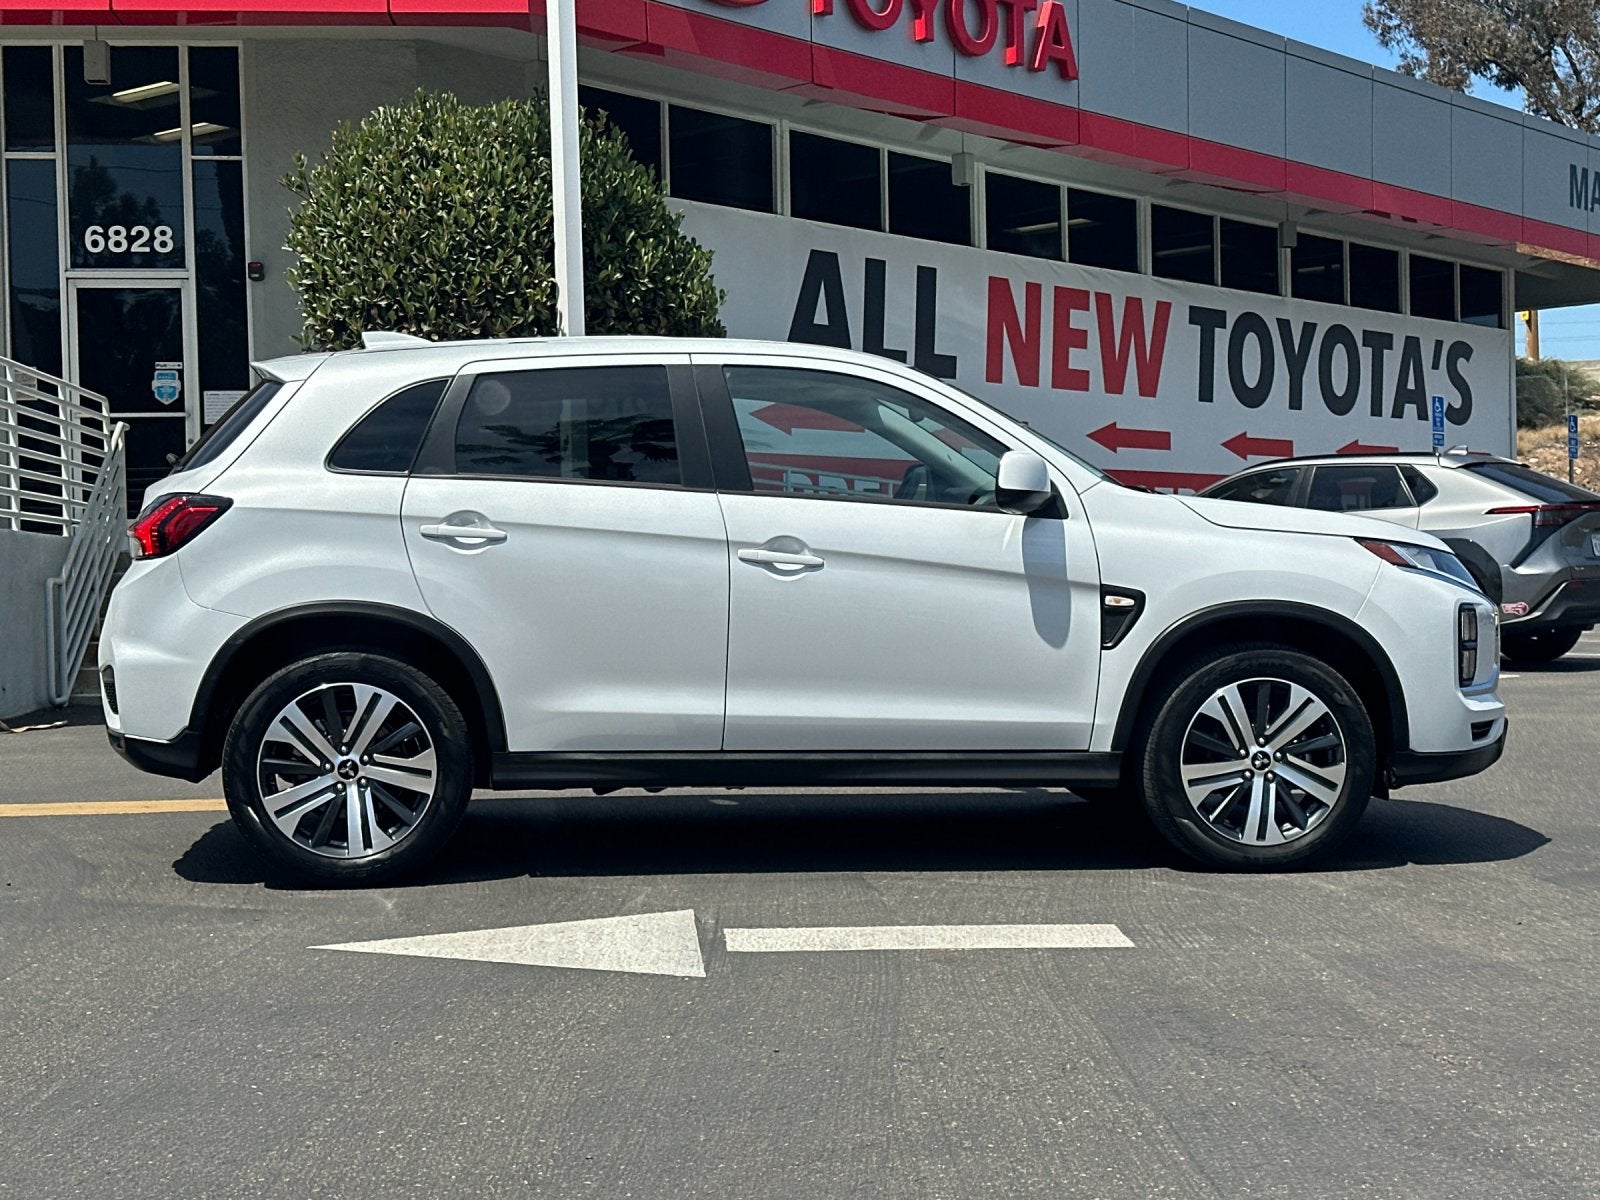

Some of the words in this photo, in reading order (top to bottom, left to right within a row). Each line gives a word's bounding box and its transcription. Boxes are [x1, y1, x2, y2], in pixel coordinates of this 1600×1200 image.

[84, 225, 174, 253] 6828
[786, 249, 957, 379] ALL
[985, 275, 1172, 398] NEW
[1188, 305, 1474, 426] TOYOTA'S
